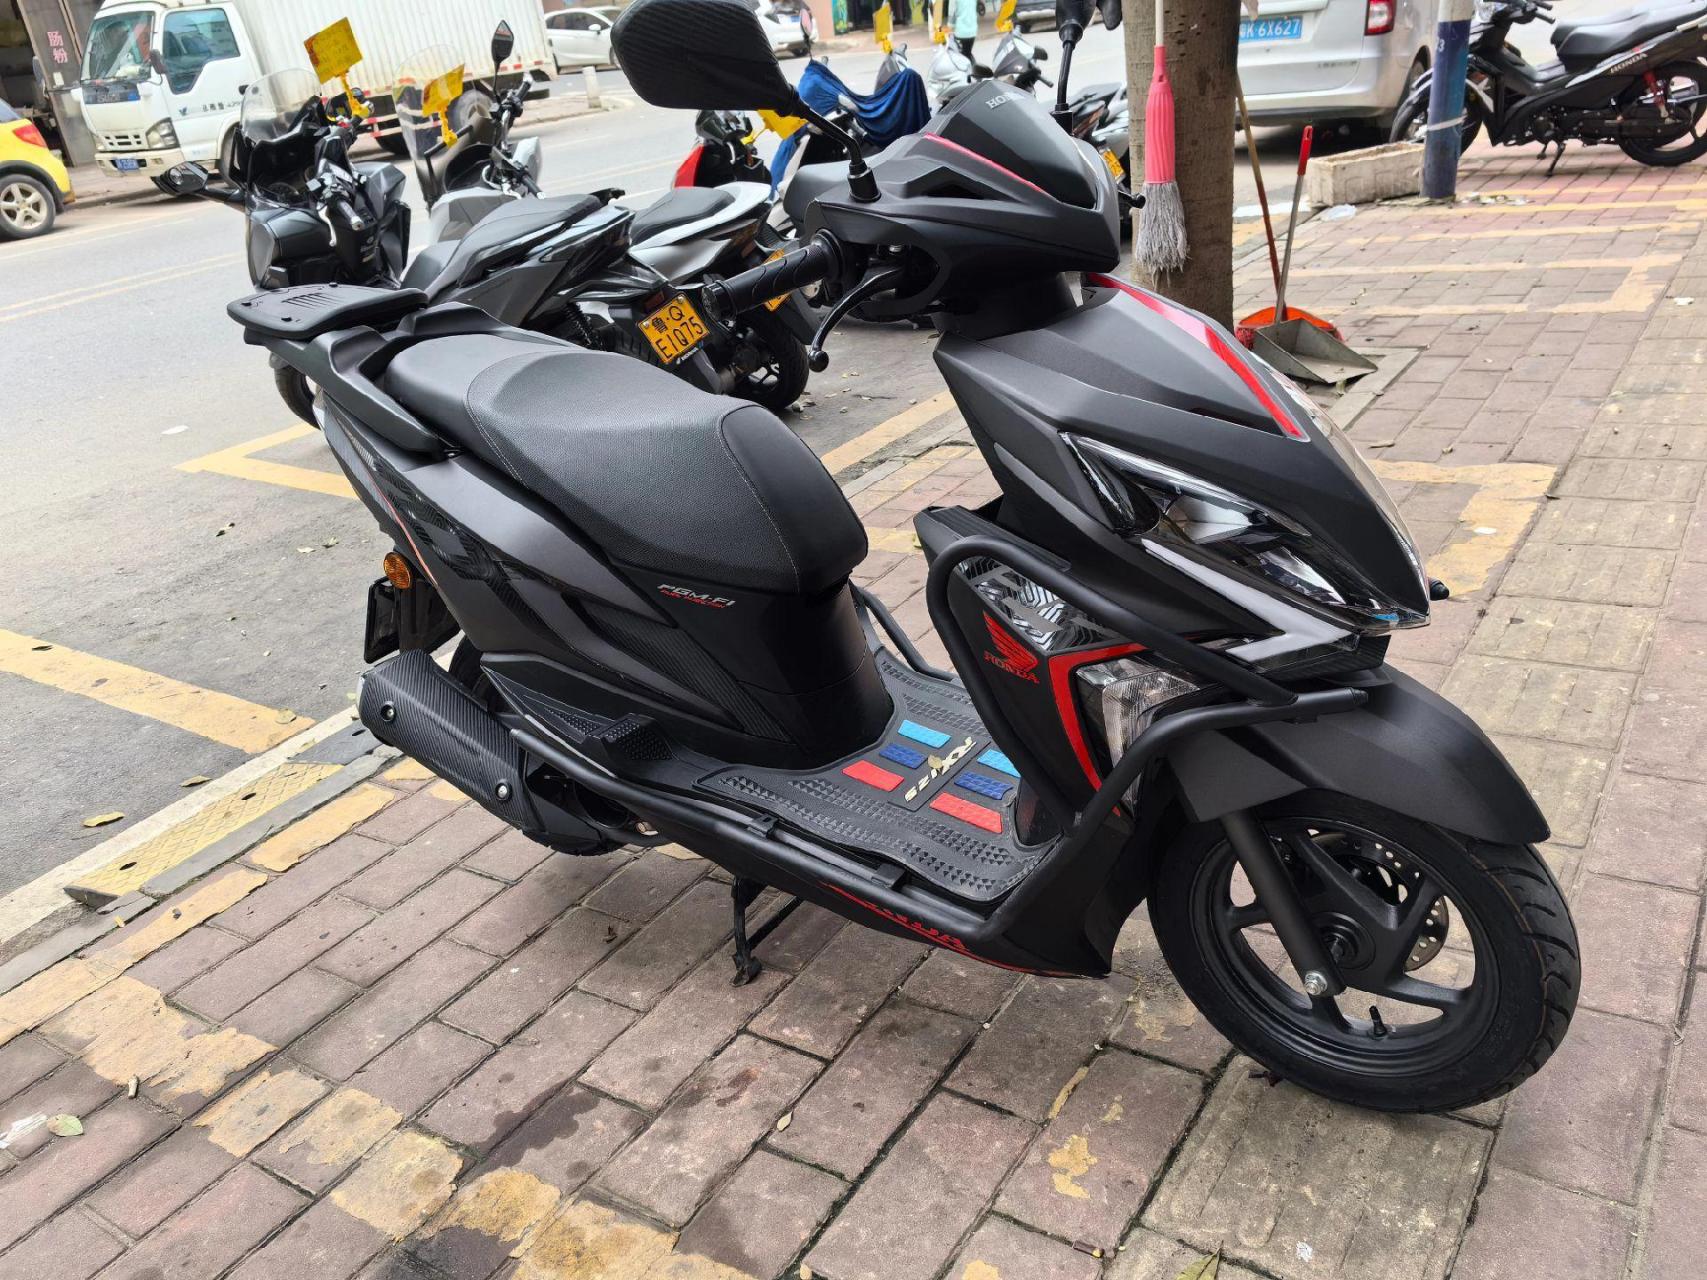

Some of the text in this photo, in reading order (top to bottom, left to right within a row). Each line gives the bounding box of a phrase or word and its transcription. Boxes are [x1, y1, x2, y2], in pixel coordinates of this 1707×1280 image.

[47, 31, 68, 64] 肠粉
[652, 306, 685, 334] 鲁·Q
[655, 316, 704, 359] E1Q75
[984, 649, 1040, 685] HONDA
